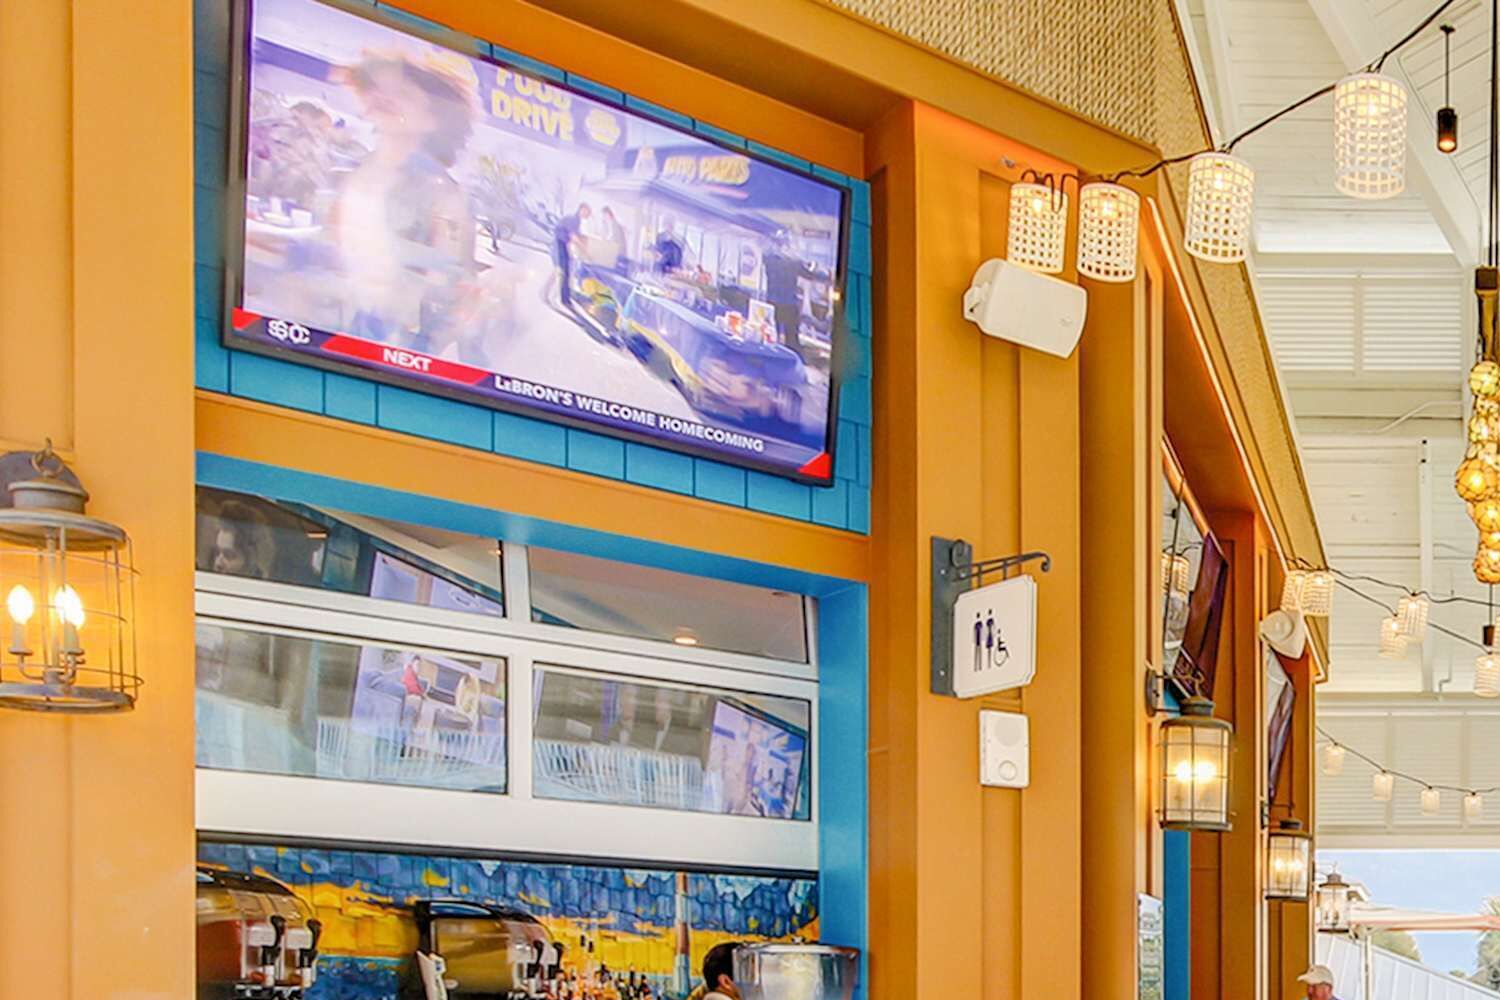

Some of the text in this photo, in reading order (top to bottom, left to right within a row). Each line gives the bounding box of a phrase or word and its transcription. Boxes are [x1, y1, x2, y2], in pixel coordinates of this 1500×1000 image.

[490, 89, 575, 141] DRIVE
[383, 348, 432, 372] NEXT
[576, 396, 656, 427] WELCOME
[659, 416, 764, 452] HOMECOMING
